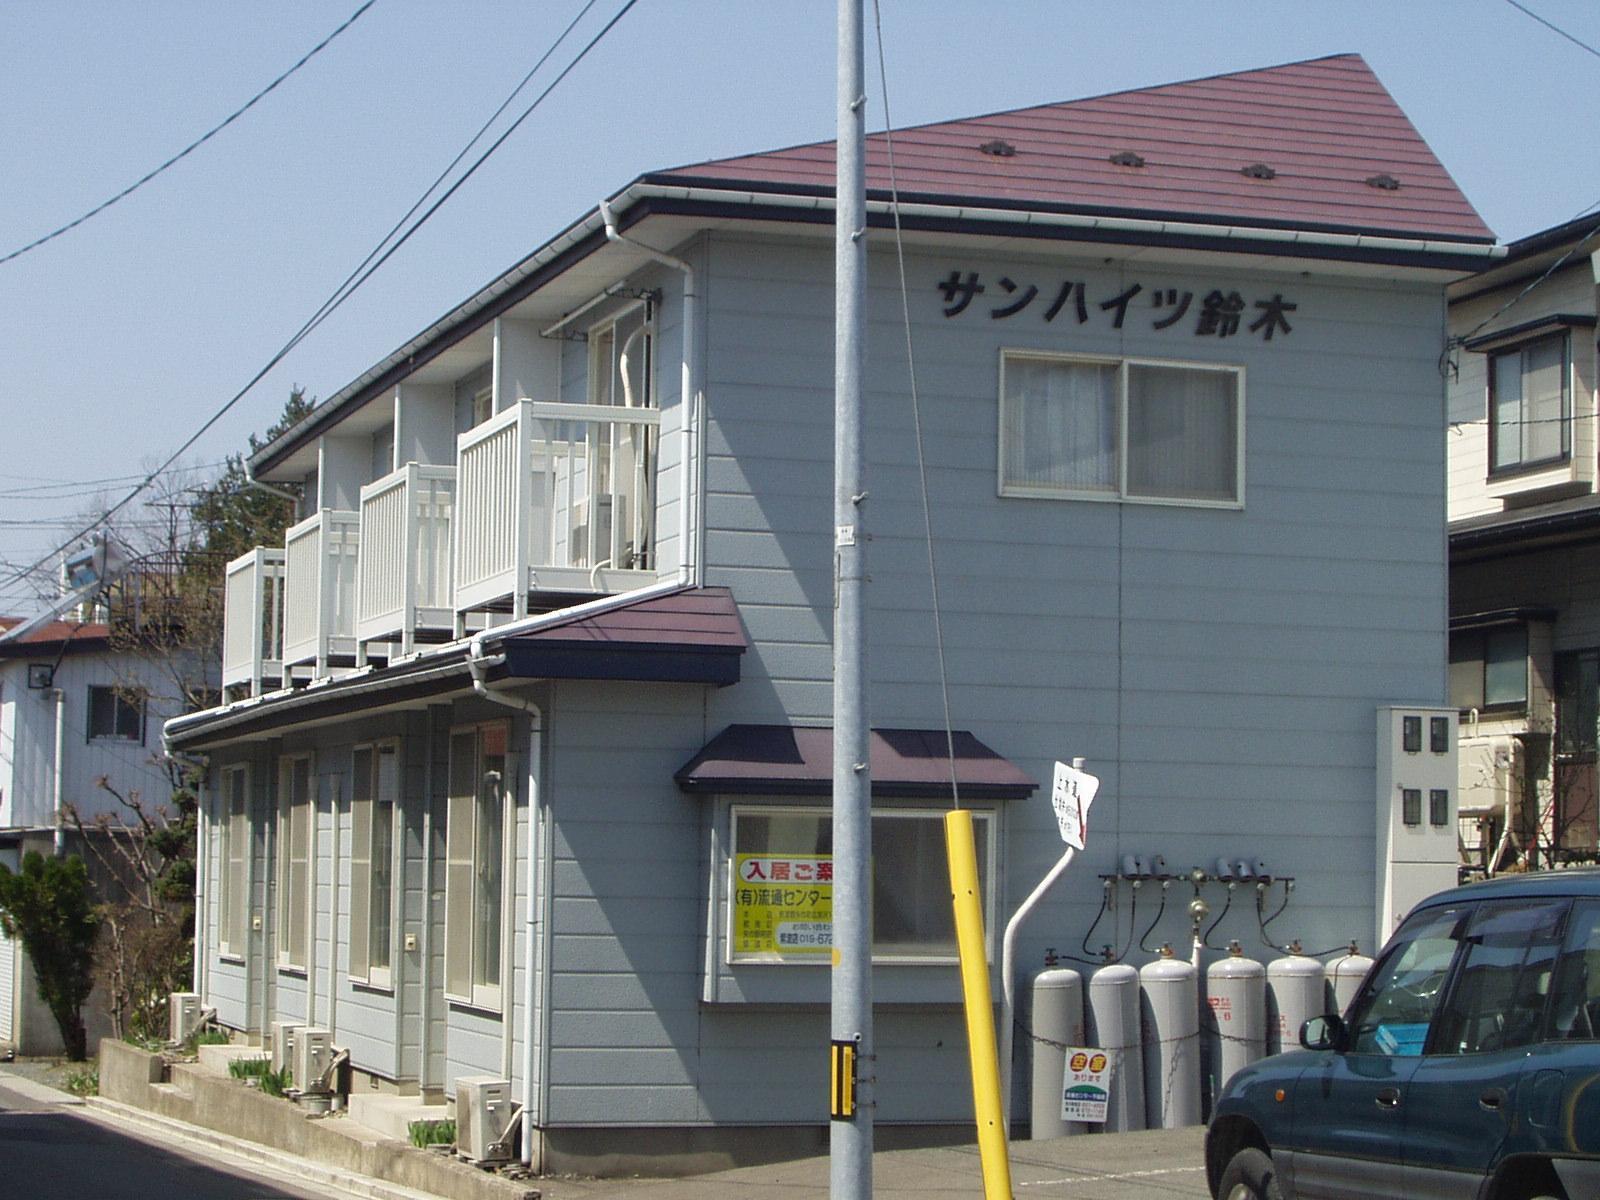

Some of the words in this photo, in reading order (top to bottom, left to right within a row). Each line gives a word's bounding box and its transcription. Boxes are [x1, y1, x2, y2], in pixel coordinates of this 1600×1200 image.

[936, 270, 1298, 341] サンハイツ鈴木
